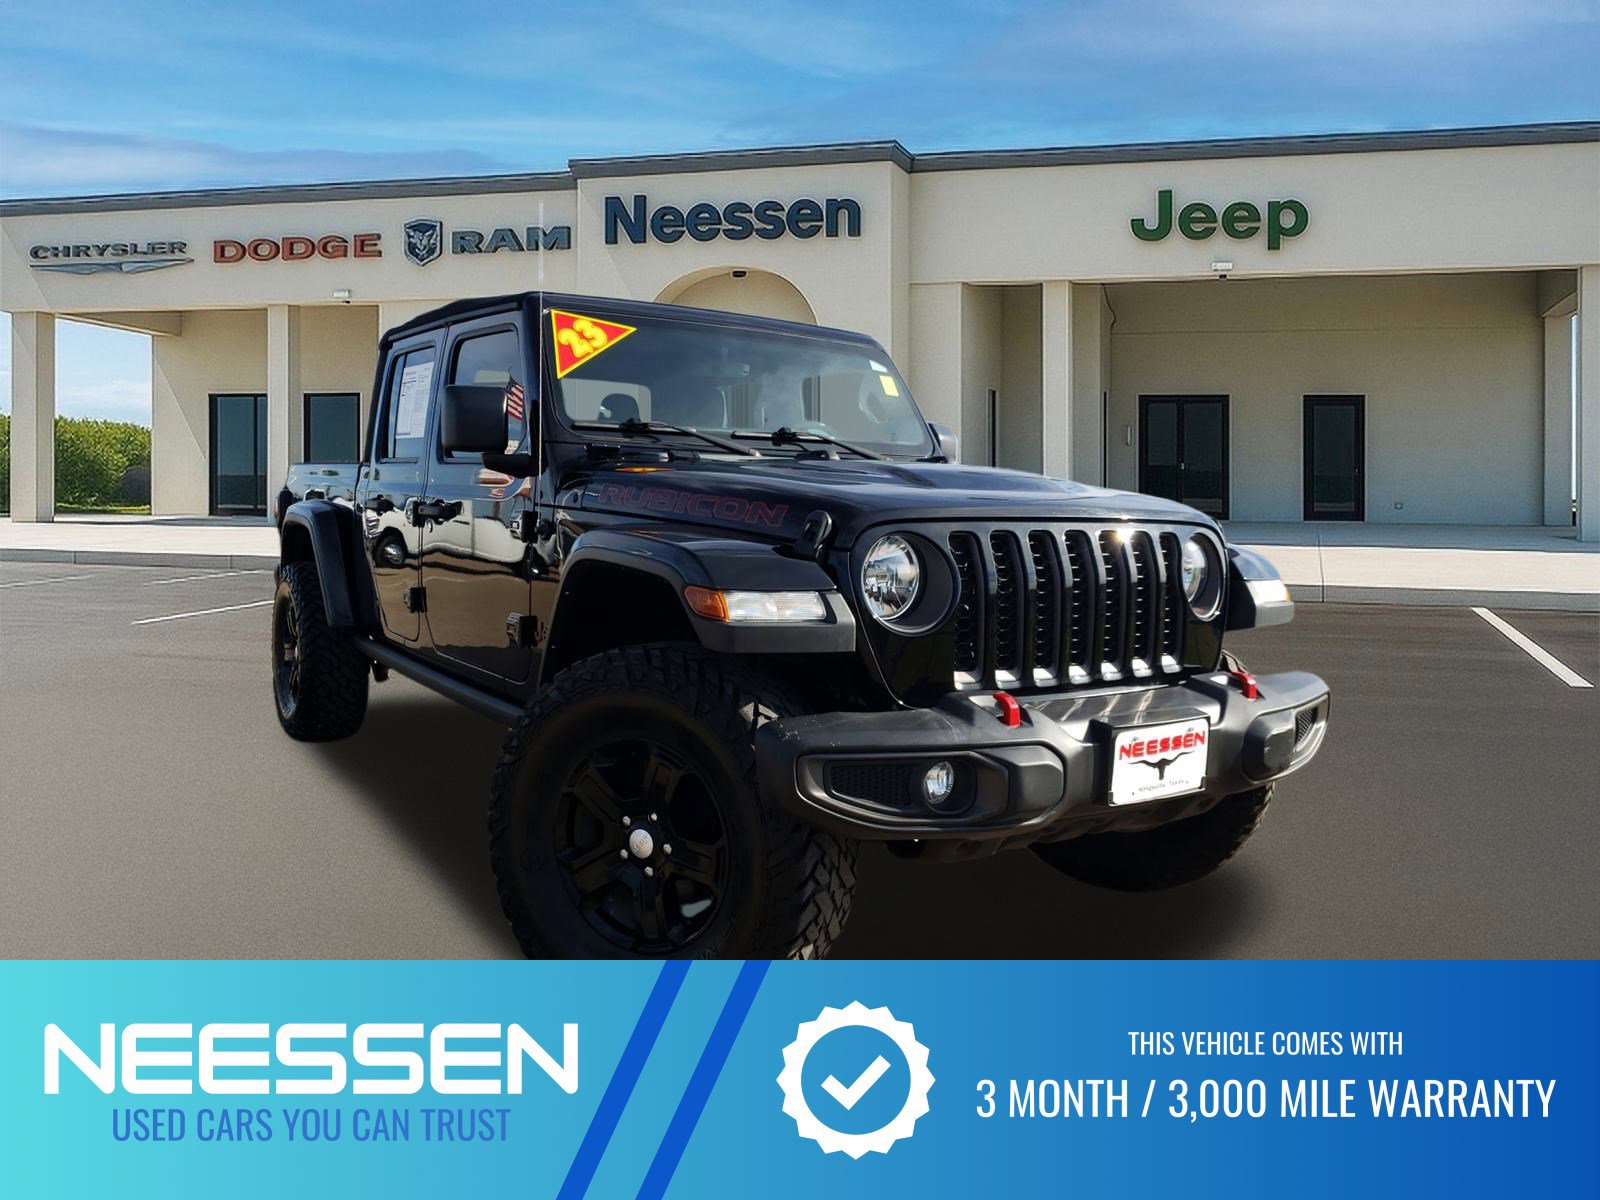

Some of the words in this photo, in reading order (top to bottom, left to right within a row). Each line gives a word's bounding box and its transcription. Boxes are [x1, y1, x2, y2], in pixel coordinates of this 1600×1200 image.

[604, 194, 862, 244] Neessen
[1130, 190, 1309, 250] Jeep
[29, 241, 188, 259] CHRYSLER
[213, 233, 383, 263] DODGE
[451, 226, 572, 253] RAM
[558, 318, 608, 358] 23
[599, 483, 789, 527] RUBICON
[1118, 731, 1206, 760] NEESSEN
